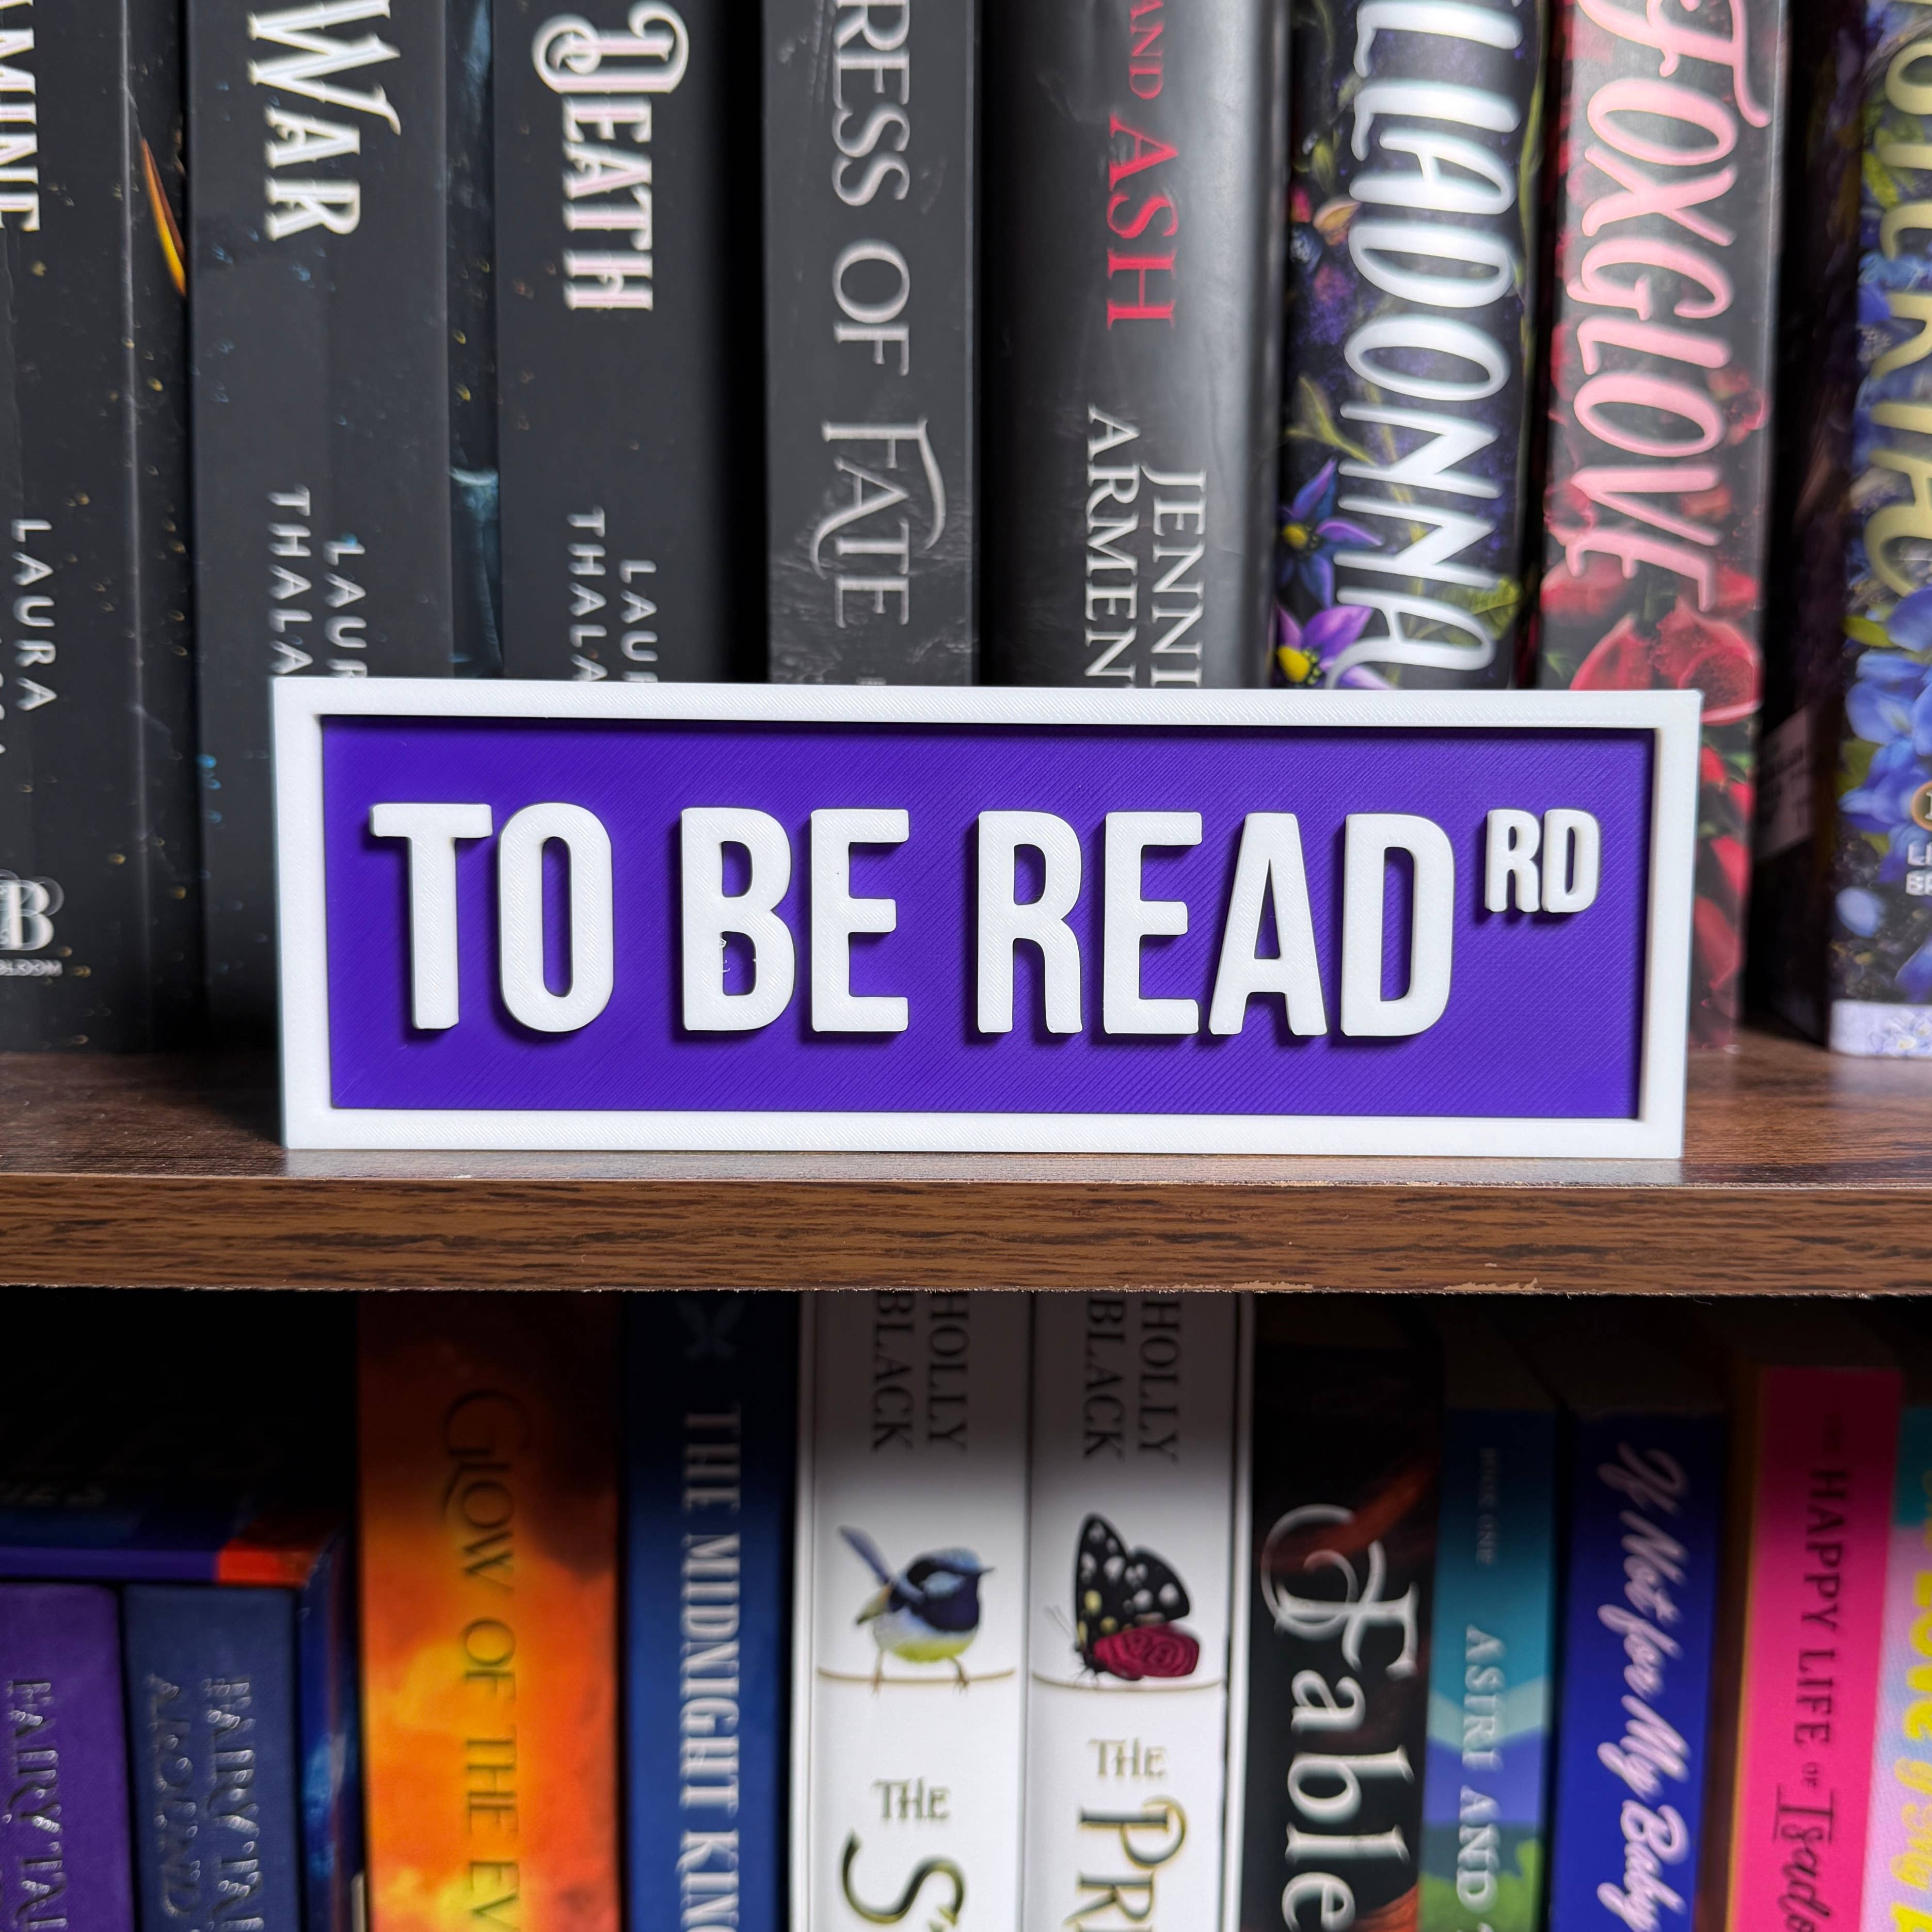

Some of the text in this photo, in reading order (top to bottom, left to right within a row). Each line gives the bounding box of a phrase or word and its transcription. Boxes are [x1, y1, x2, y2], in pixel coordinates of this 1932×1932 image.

[247, 0, 401, 241] WAR
[532, 2, 689, 311] DEATH
[832, 237, 911, 376] OF
[1106, 111, 1179, 330] ASH
[11, 519, 57, 711] LAURA
[268, 484, 313, 674] THALA
[809, 417, 946, 628] FATE
[1085, 403, 1140, 688] ARMEN
[1140, 461, 1207, 688] JENNI
[370, 802, 1600, 1037] TO BE READ RD
[871, 1292, 916, 1454] BLACK
[929, 1292, 970, 1452] HOLLY
[1082, 1296, 1126, 1461] BLACK
[1138, 1297, 1183, 1466] HOLLY
[1801, 1468, 1849, 1631] HAPPY
[462, 1617, 516, 1700] OF
[675, 1403, 741, 1932] THE MIDNIGHT KIN
[1259, 1503, 1419, 1932] Fable
[1794, 1648, 1836, 1746] LIFE
[465, 1725, 518, 1836] THE
[1456, 1784, 1501, 1914] AND
